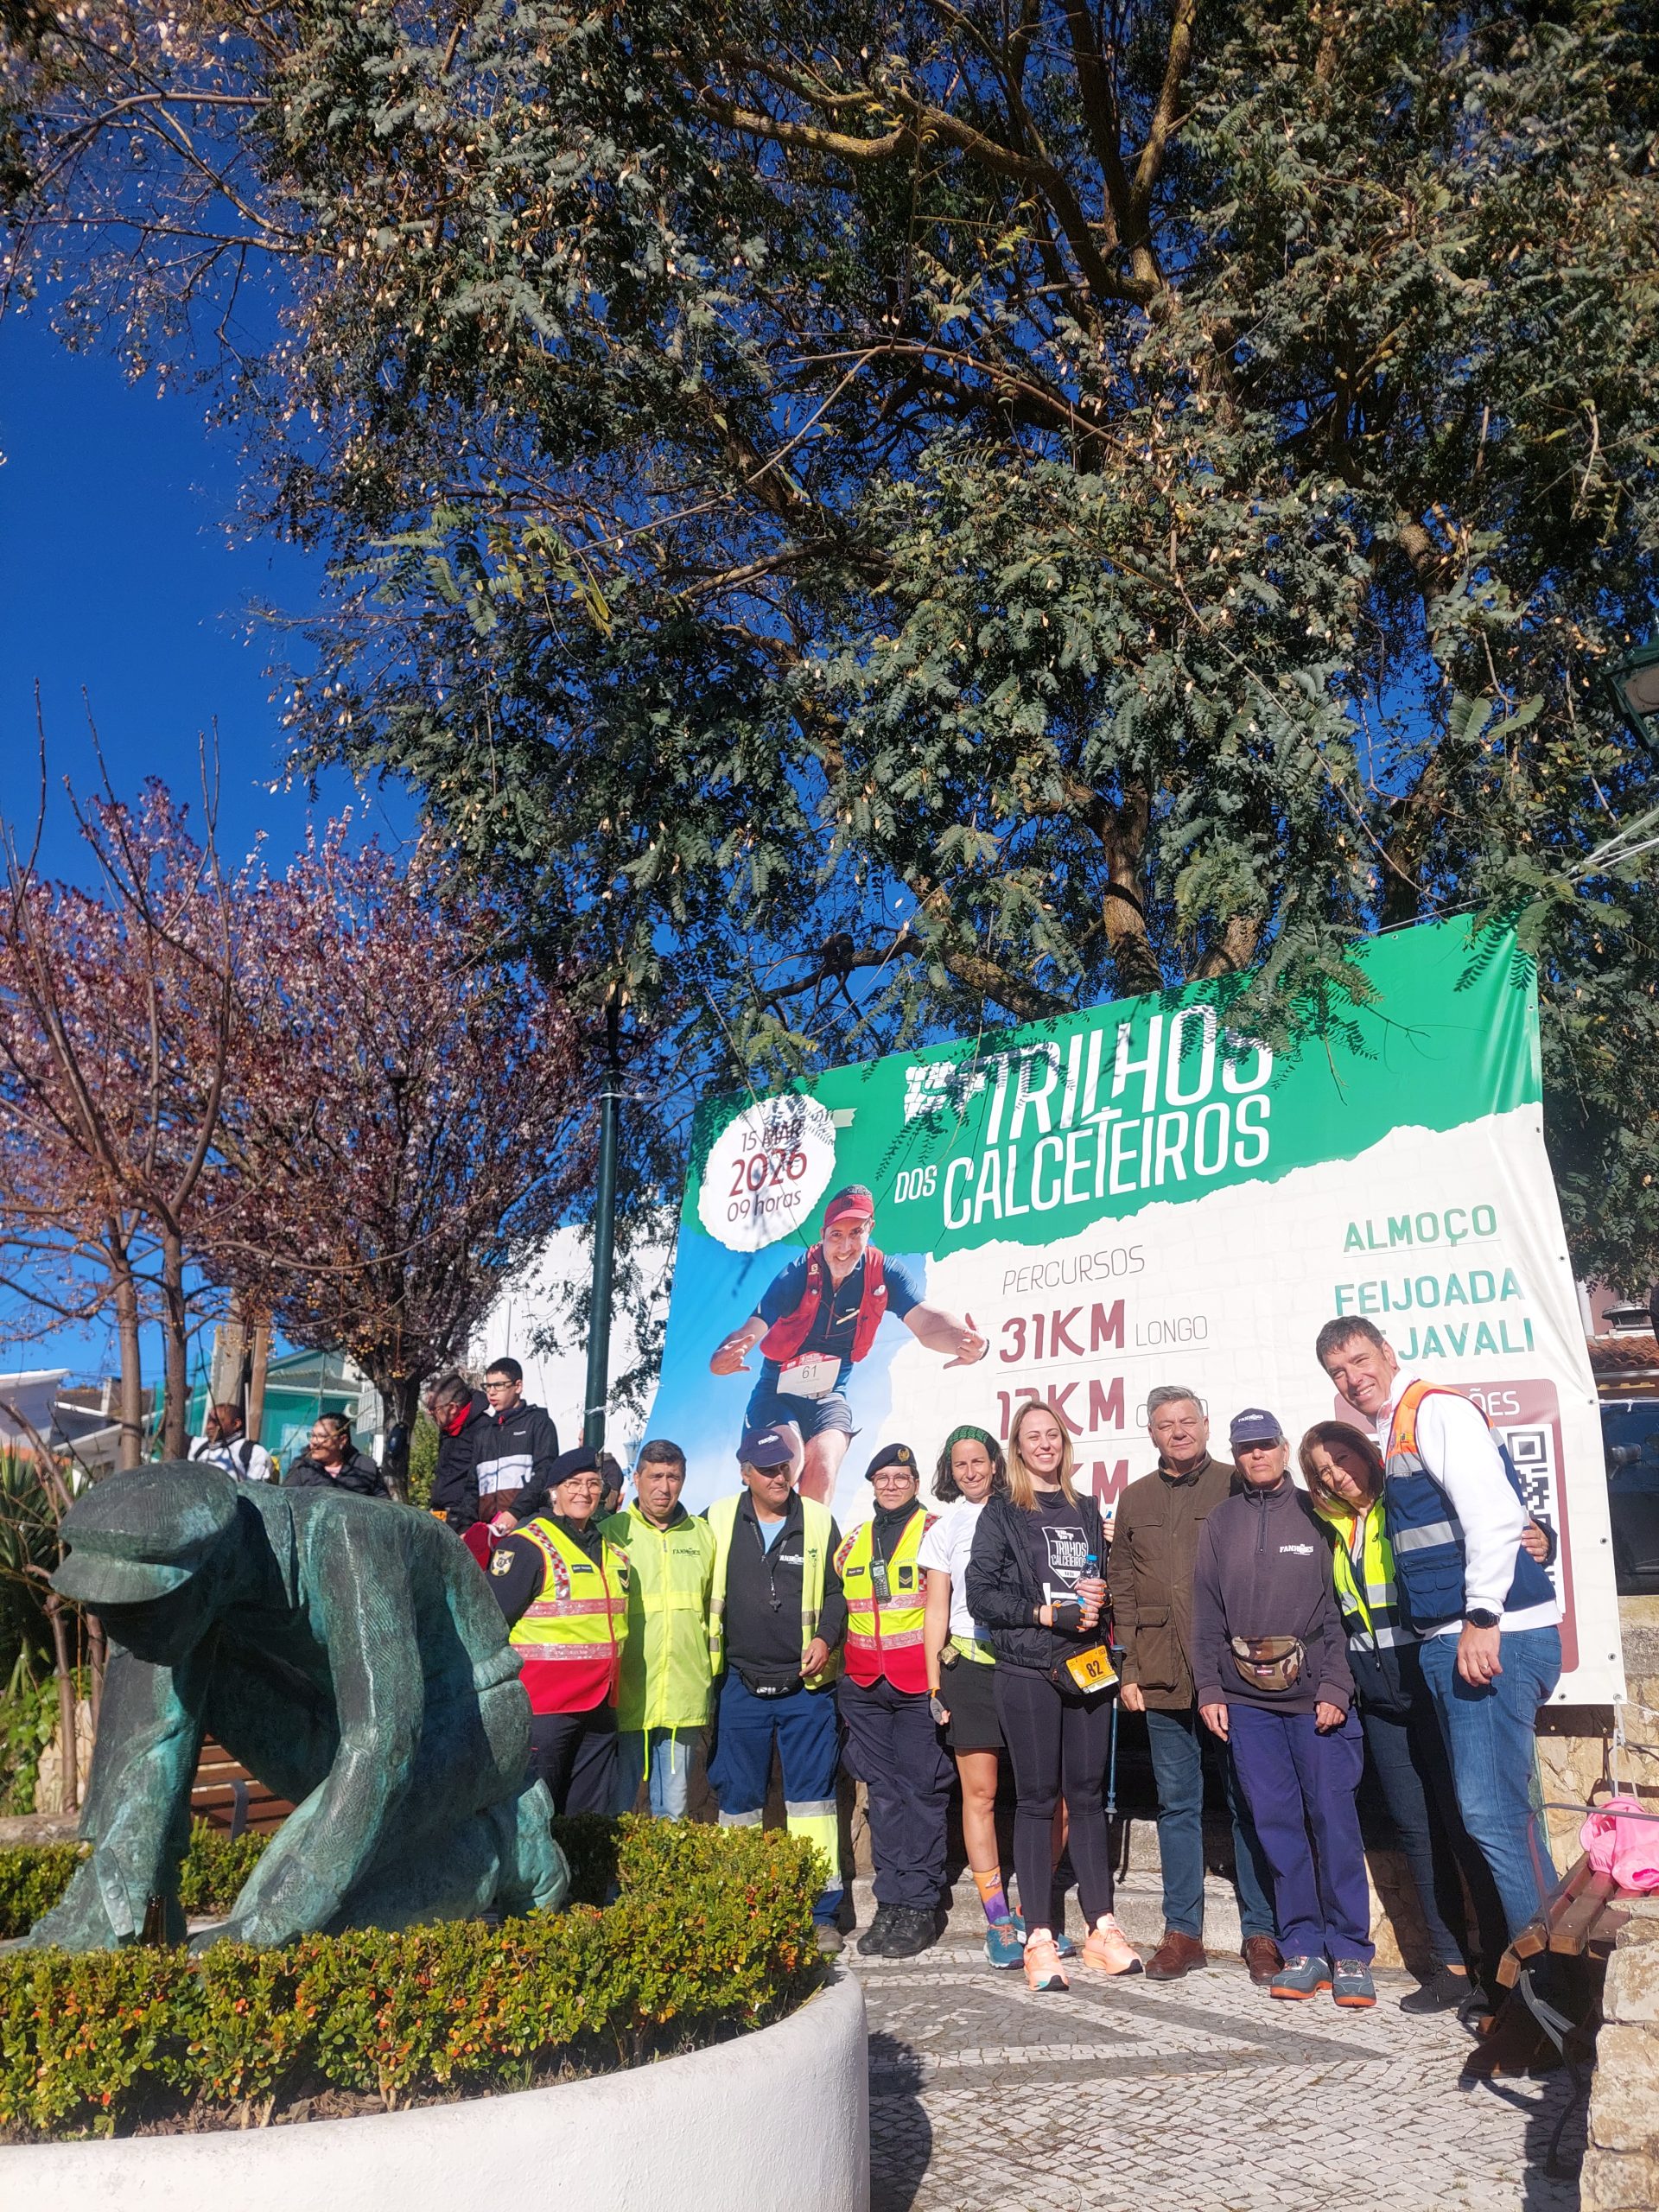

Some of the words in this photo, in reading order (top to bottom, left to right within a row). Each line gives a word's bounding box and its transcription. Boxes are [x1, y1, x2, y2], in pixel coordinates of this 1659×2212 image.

[960, 1004, 1274, 1146] TRILHOS
[741, 1131, 757, 1153] 15
[893, 1164, 938, 1205] DOS
[943, 1093, 1271, 1230] CALCETEIROS
[728, 1144, 808, 1198] 2026
[727, 1198, 751, 1222] 09
[754, 1190, 802, 1217] horas
[1343, 1204, 1497, 1253] ALMOÇO
[1002, 1244, 1146, 1295] PERCURSOS
[1334, 1267, 1526, 1317] FEIJOADA
[999, 1299, 1126, 1363] 31KM
[1135, 1315, 1209, 1347] LONGO
[1397, 1318, 1535, 1361] JAVALI
[802, 1364, 817, 1379] 61
[1050, 1540, 1087, 1558] TRILHOS
[1086, 1660, 1104, 1678] 82
